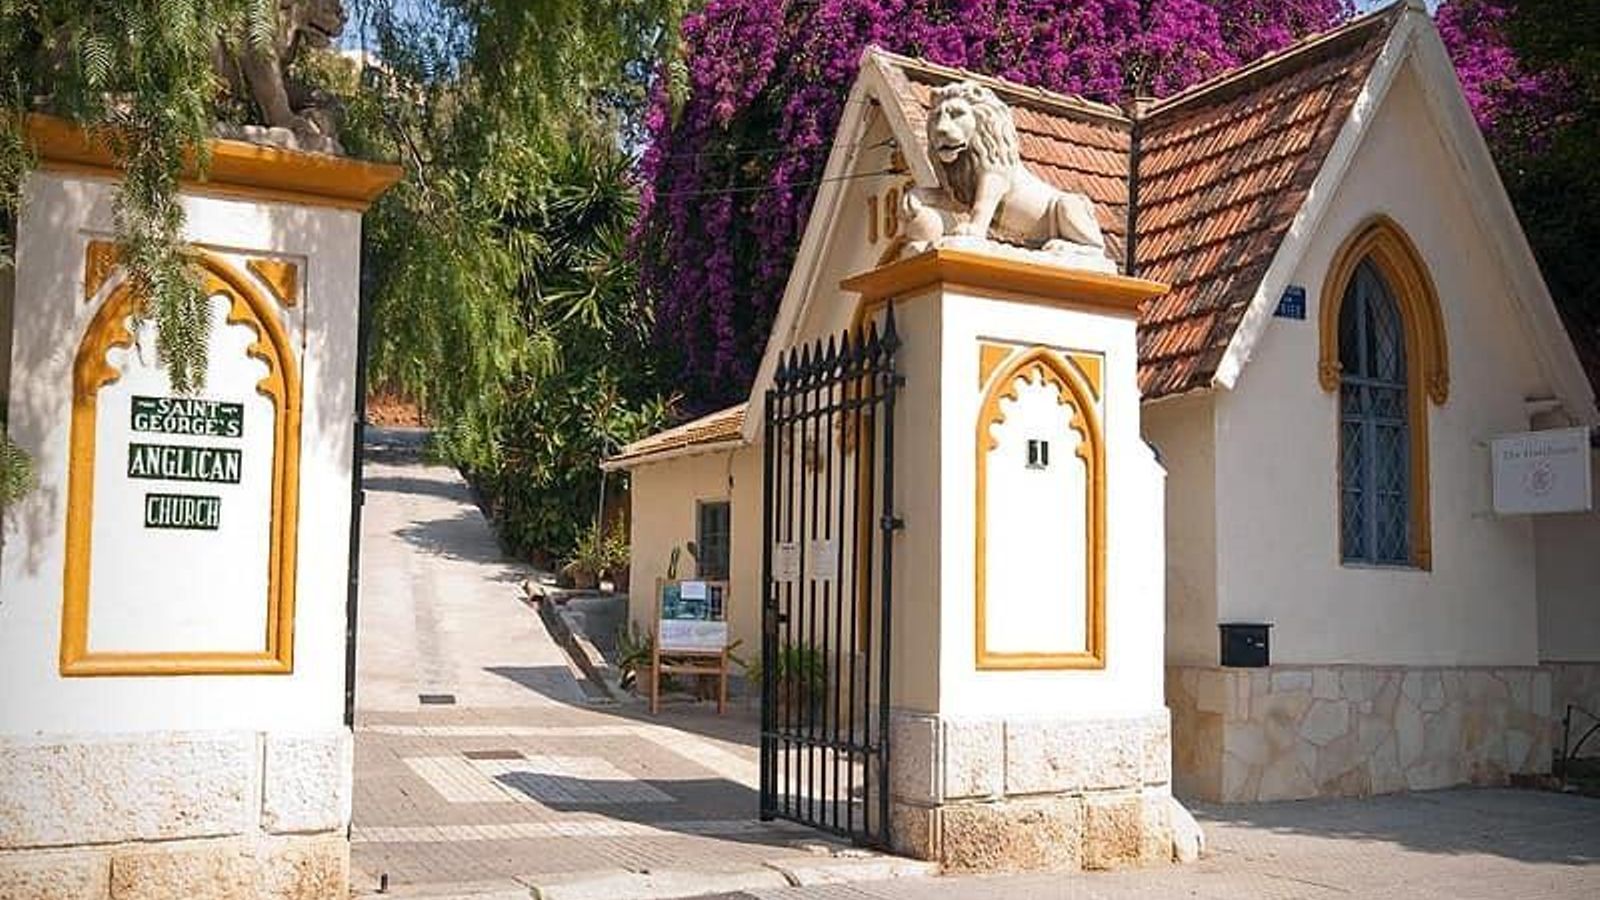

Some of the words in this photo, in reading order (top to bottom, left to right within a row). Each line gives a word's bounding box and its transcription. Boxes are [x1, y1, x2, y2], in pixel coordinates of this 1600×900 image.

[157, 399, 221, 418] SAINT
[134, 413, 240, 436] GEORGE'S
[130, 447, 239, 480] ANGLICAN
[147, 497, 218, 526] CHURCH
